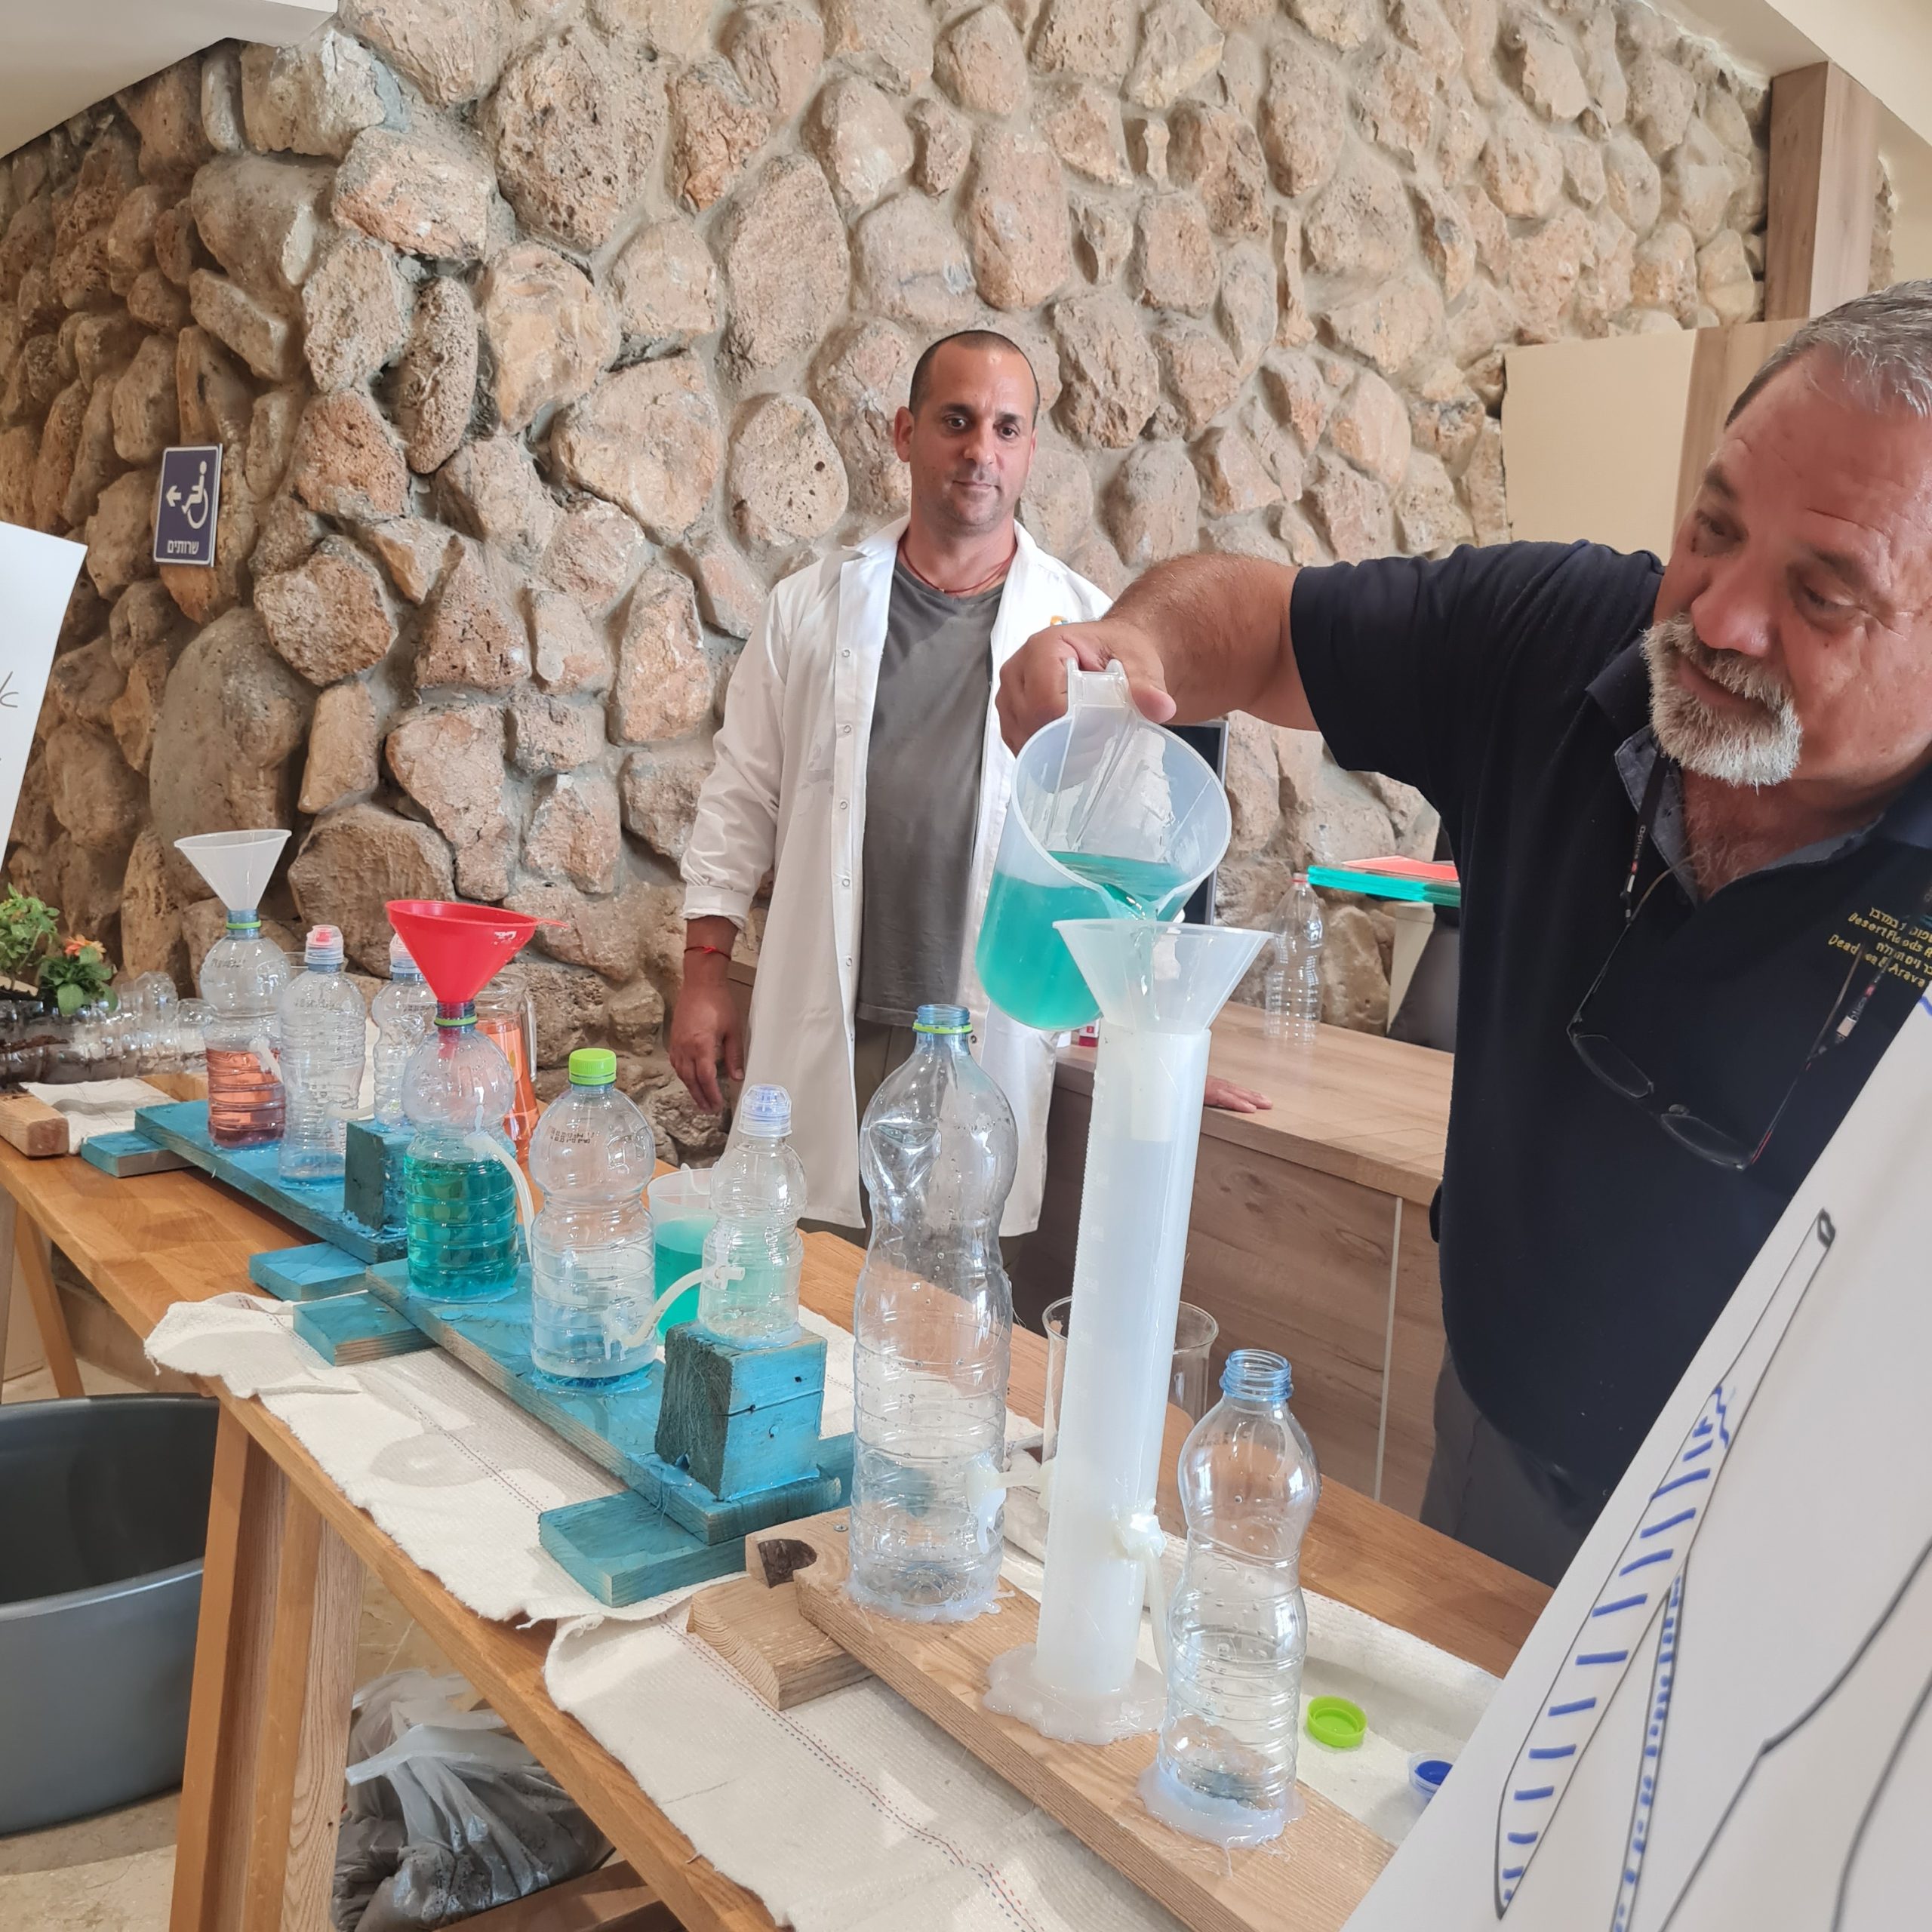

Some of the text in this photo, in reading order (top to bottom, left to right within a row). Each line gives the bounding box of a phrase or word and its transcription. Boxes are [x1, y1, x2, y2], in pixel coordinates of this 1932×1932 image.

[167, 540, 200, 555] שרותים
[1847, 912, 1887, 937] Desert
[1828, 934, 1861, 955] Dead
[1888, 963, 1925, 988] Arava
